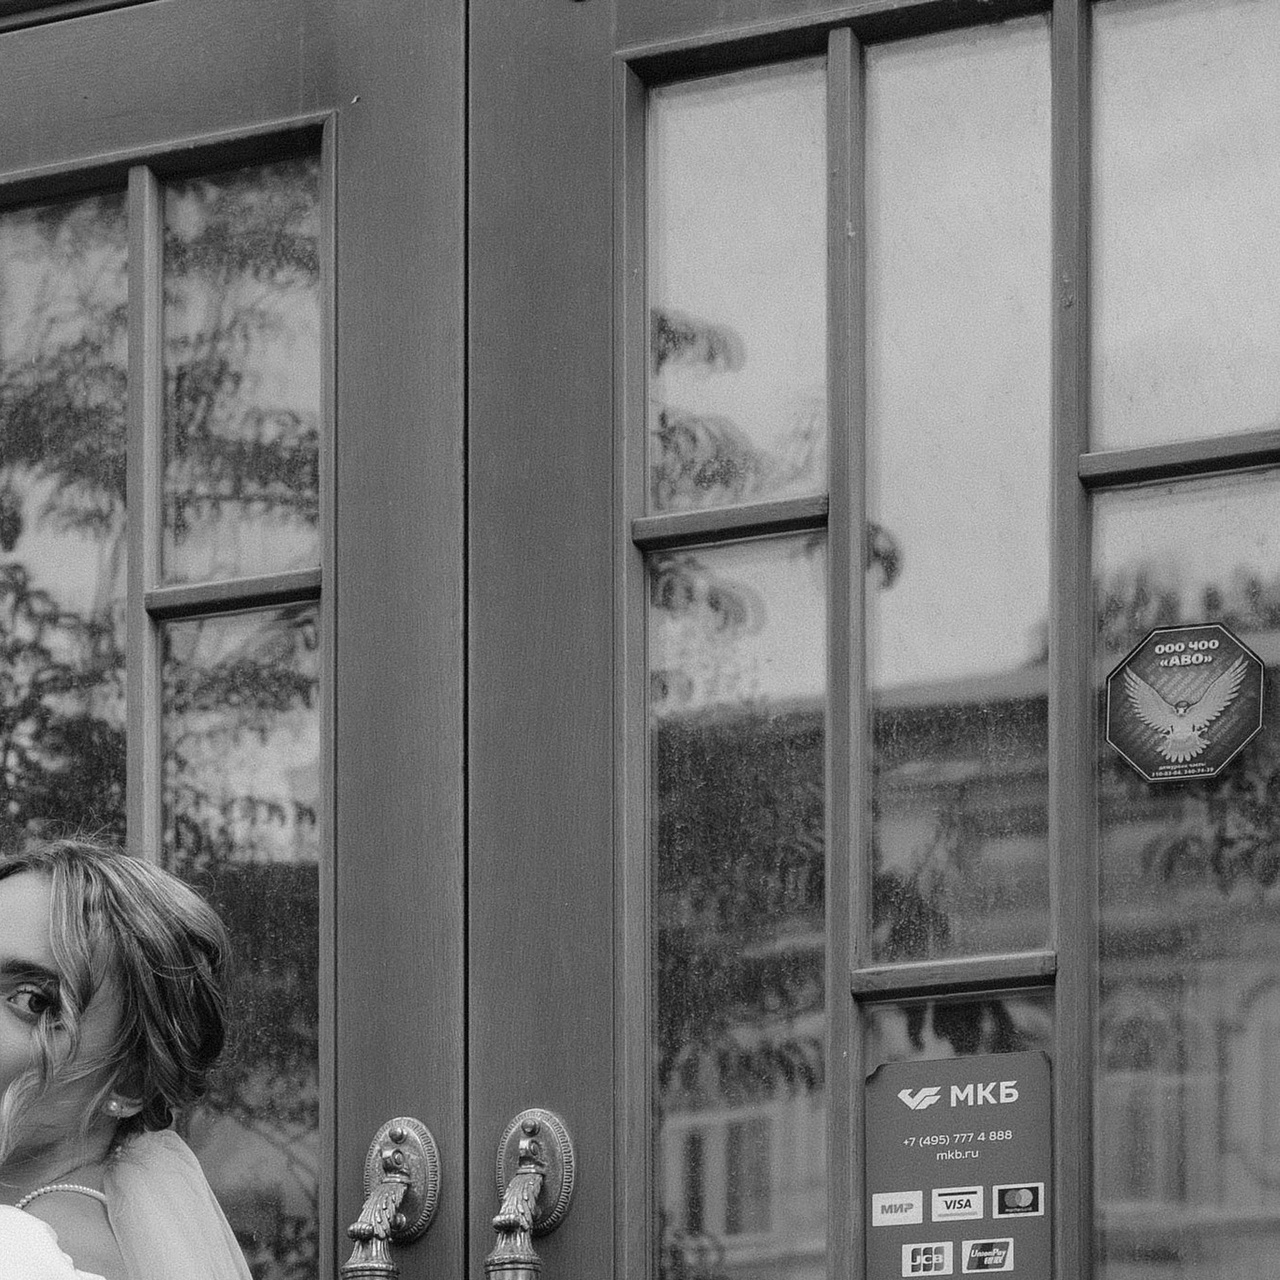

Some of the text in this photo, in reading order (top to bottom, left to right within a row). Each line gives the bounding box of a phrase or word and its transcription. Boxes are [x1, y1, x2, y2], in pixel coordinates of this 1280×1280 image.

[1154, 639, 1220, 655] ООО ЧОО
[1160, 653, 1213, 667] «АВО»
[950, 1080, 1019, 1107] МКБ
[903, 1130, 1013, 1148] +7 (495) 777 4 888
[936, 1149, 979, 1160] mkb.ru
[880, 1203, 914, 1215] МИР
[944, 1198, 972, 1210] VISA
[911, 1254, 944, 1265] JCB
